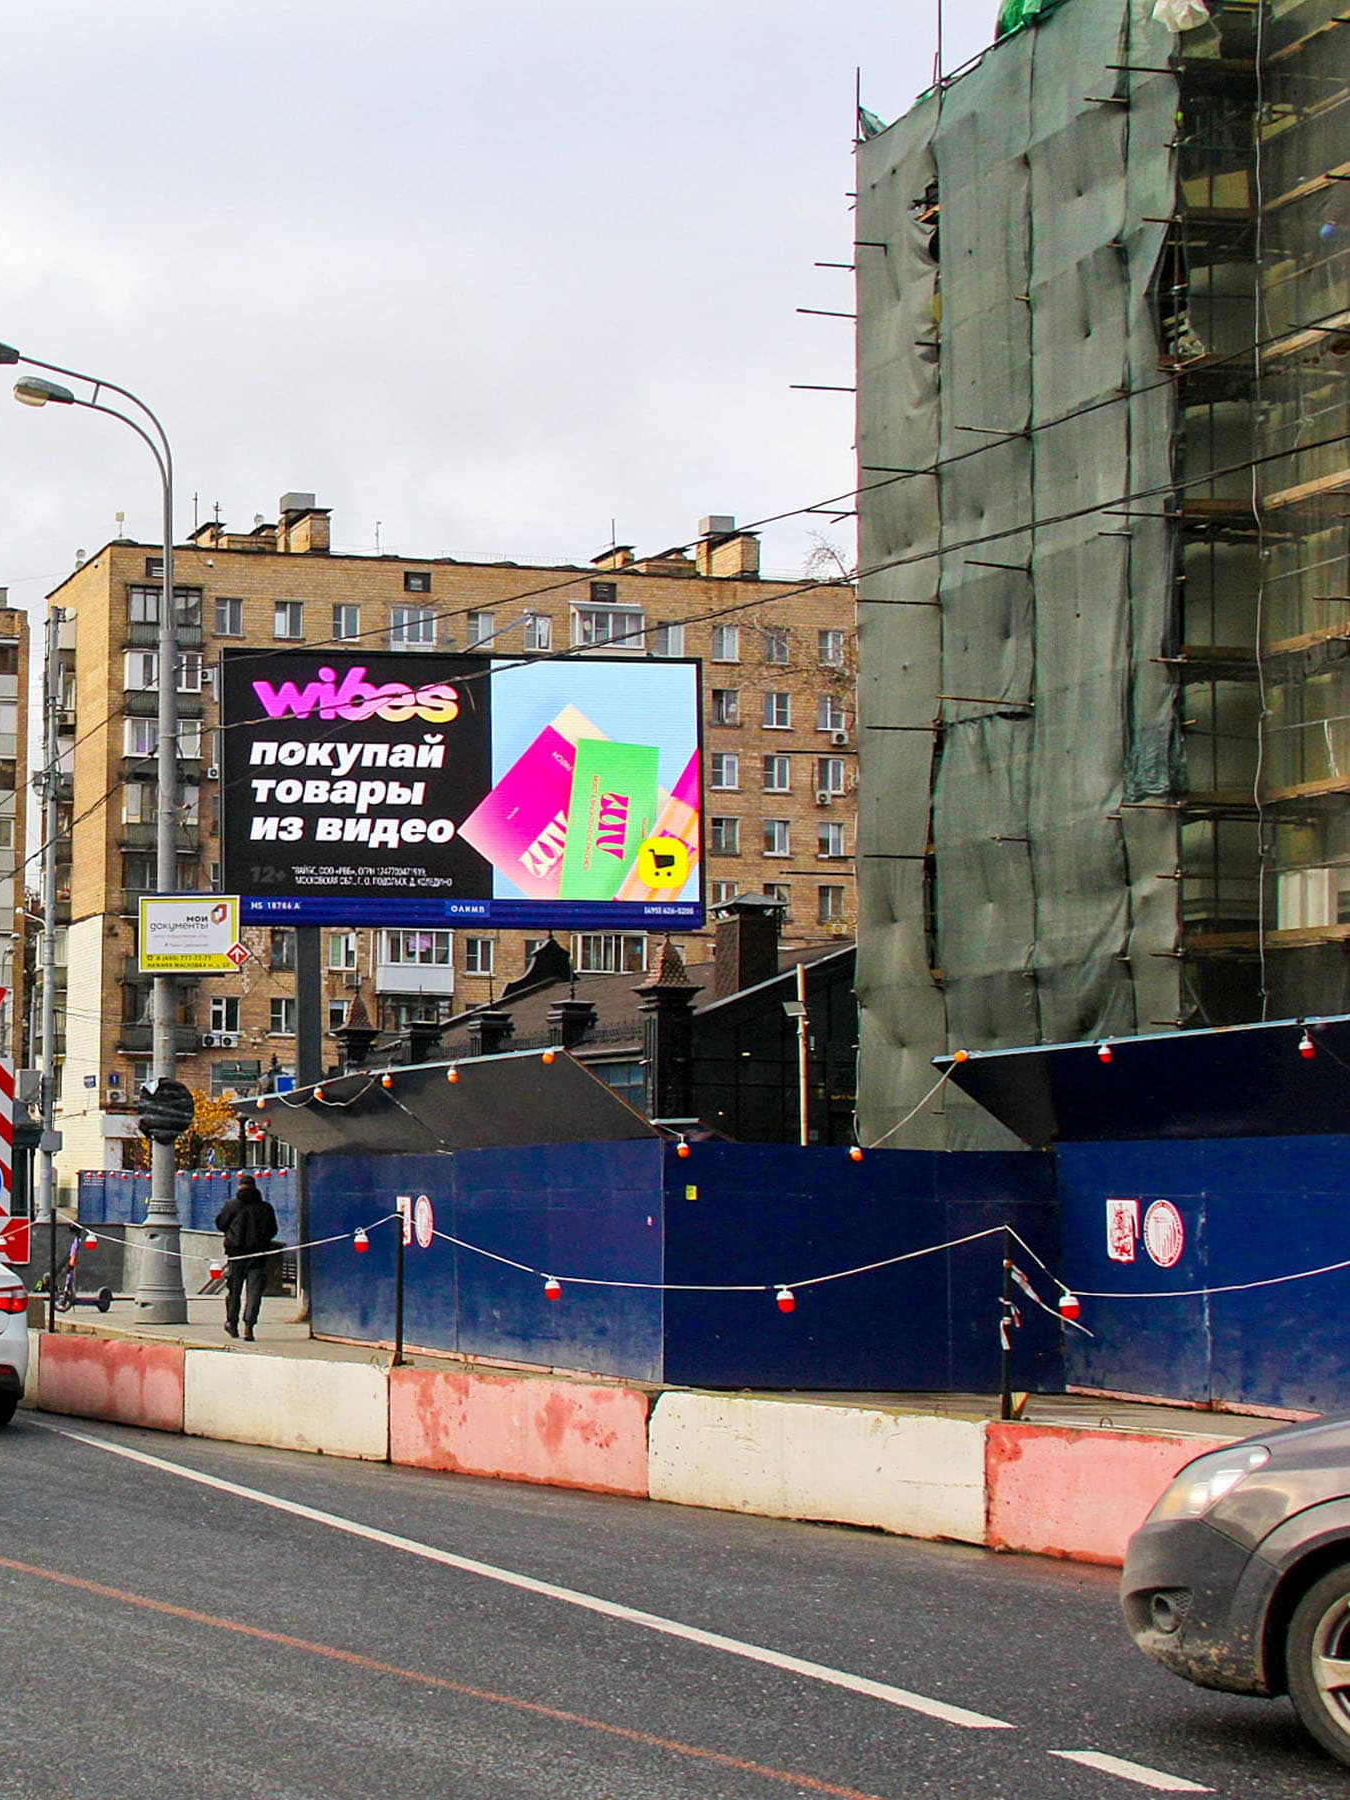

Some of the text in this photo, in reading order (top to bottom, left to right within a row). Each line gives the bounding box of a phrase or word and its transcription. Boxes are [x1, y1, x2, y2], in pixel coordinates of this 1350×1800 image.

[252, 667, 460, 723] wibes
[249, 733, 445, 777] покупай
[251, 779, 426, 814] товары
[250, 816, 456, 849] из видео
[251, 866, 287, 884] 12+
[451, 905, 485, 913] ОЛИМП
[150, 923, 208, 932] документы
